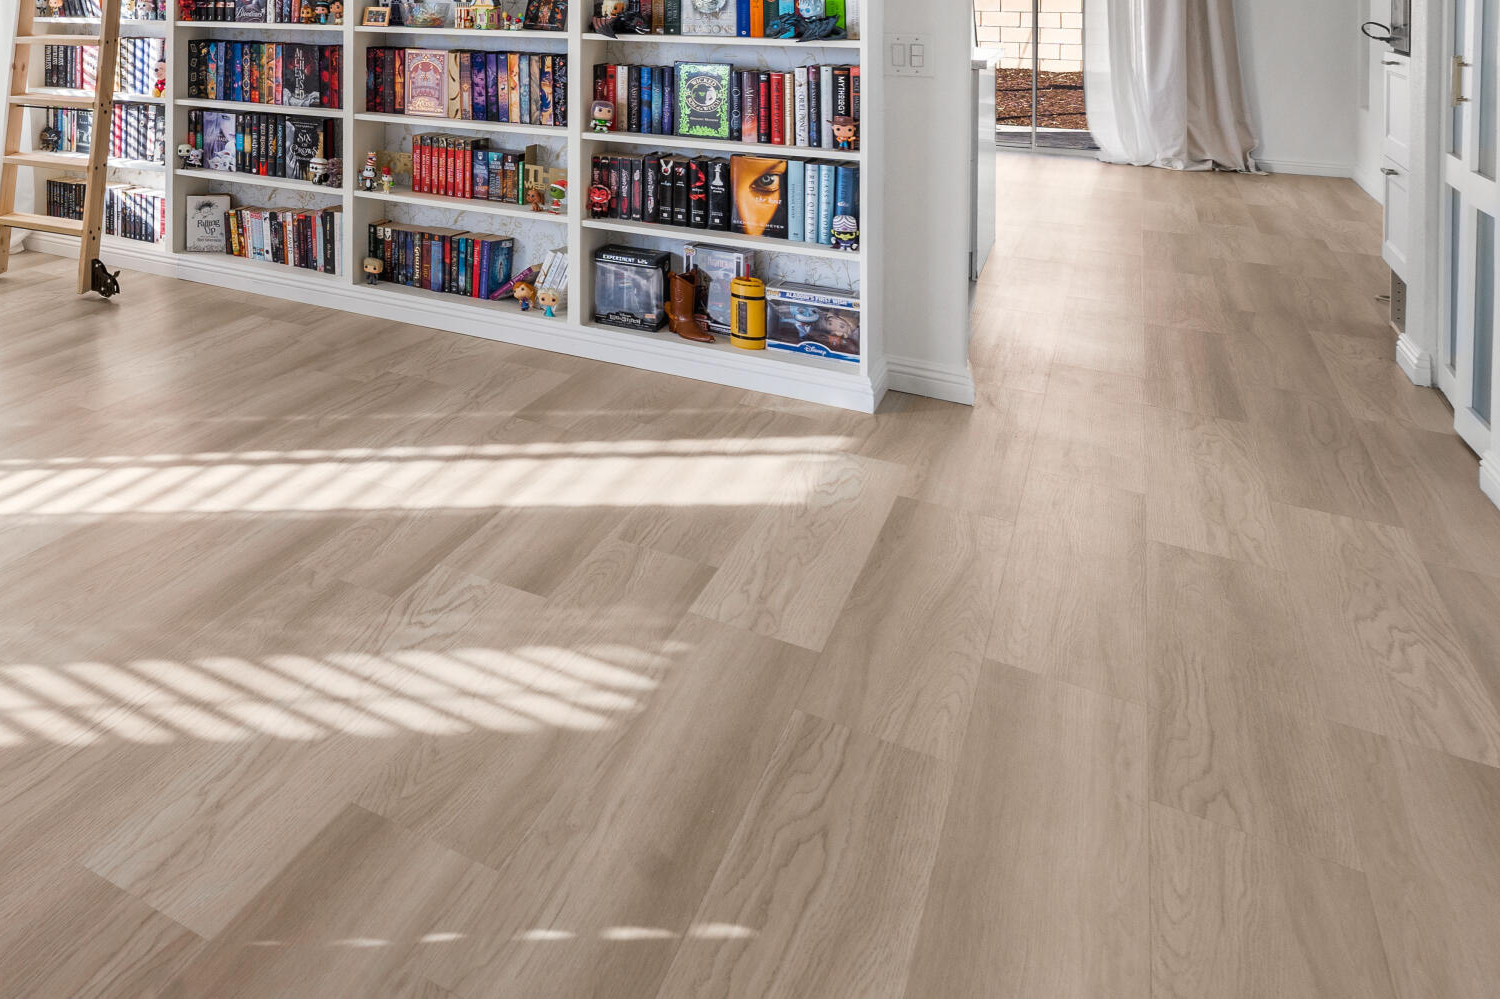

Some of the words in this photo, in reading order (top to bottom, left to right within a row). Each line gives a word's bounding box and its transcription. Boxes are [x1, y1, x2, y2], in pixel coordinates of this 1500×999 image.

[297, 133, 312, 144] SIX
[768, 197, 782, 205] host
[204, 226, 215, 235] Up
[602, 254, 635, 263] EXPERIMENT
[804, 345, 826, 356] Disney
